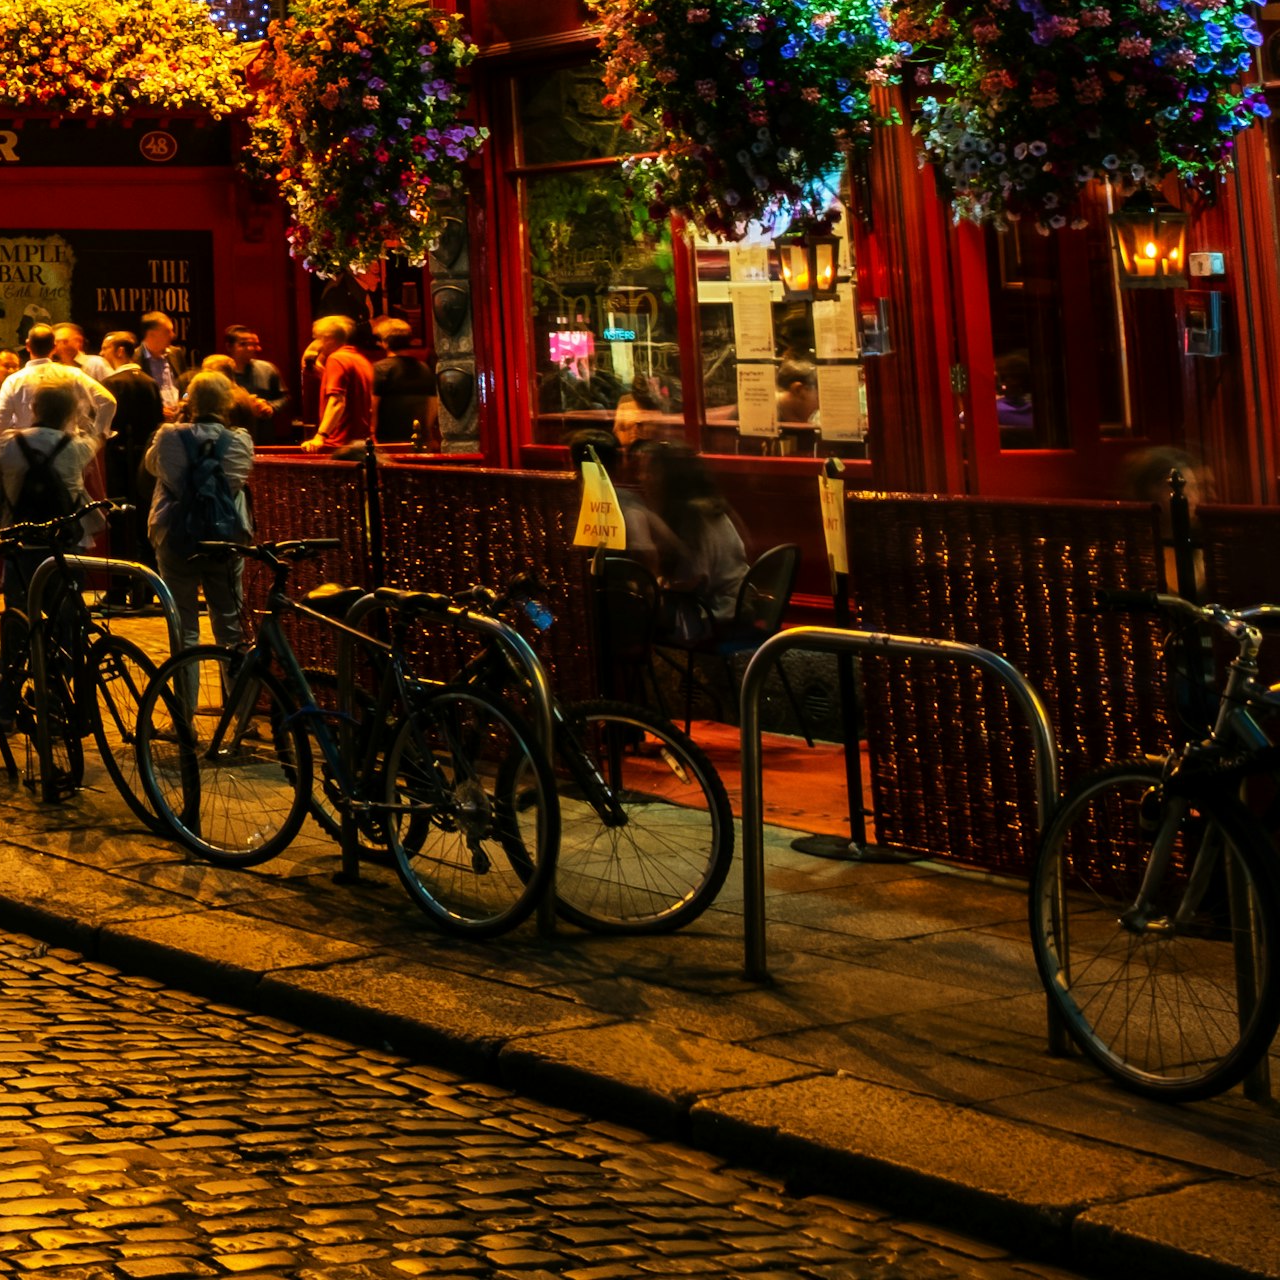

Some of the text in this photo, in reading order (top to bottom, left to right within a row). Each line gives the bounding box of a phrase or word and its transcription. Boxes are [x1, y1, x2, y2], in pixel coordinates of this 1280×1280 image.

[144, 136, 171, 157] 48
[148, 259, 190, 284] THE
[97, 287, 190, 313] EMPEROR
[590, 501, 612, 514] WET
[583, 523, 618, 537] PAINT
